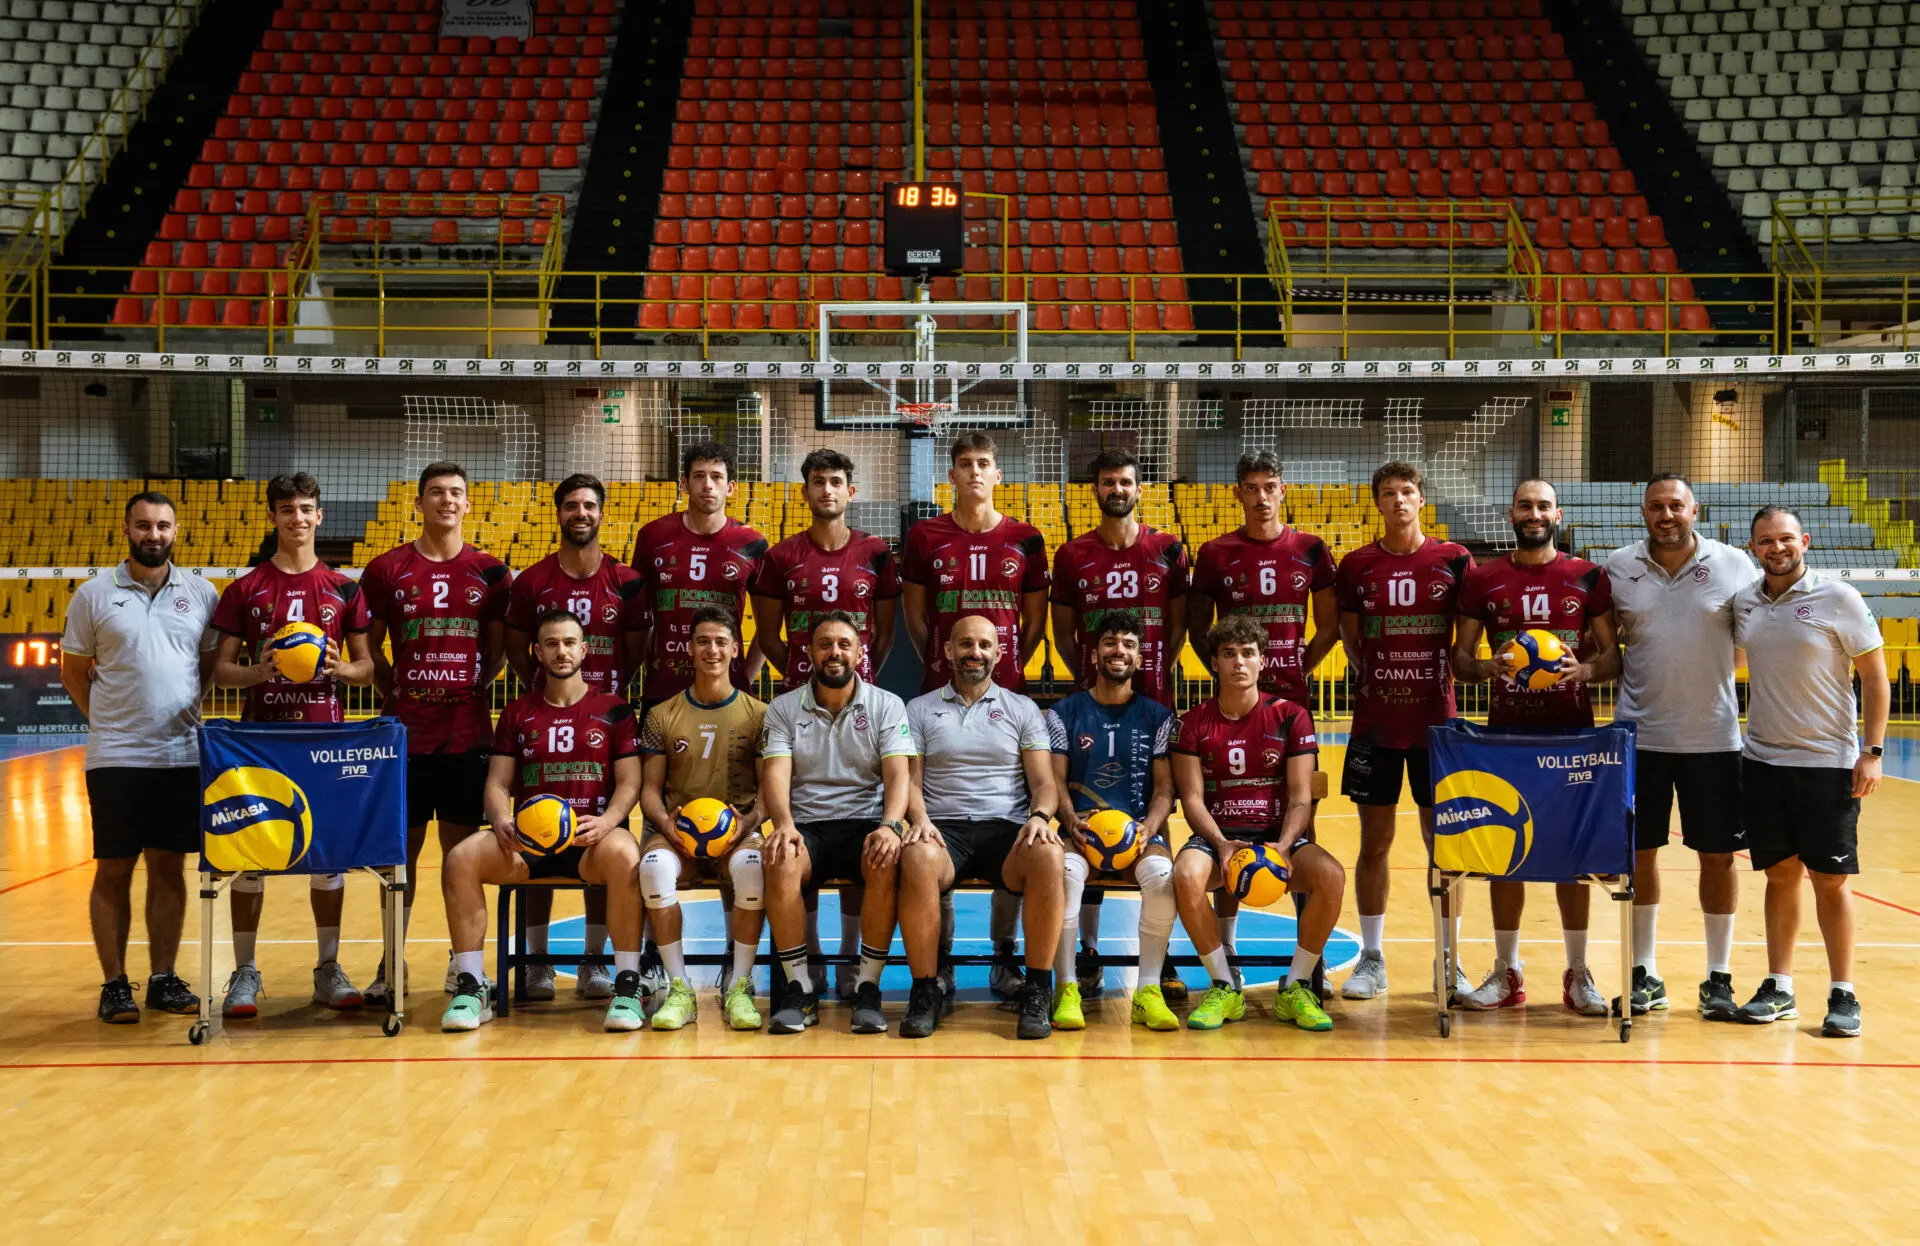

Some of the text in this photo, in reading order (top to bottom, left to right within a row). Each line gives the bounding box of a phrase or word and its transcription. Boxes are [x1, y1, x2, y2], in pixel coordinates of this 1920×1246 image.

[899, 186, 957, 206] 18 36
[690, 554, 707, 581] 5
[970, 554, 986, 580] 11
[822, 574, 838, 602] 3
[1106, 570, 1138, 598] 23
[1260, 568, 1276, 595] 6
[1388, 579, 1416, 606] 10
[432, 582, 448, 608] 2
[1522, 594, 1550, 620] 14
[287, 599, 304, 622] 4
[567, 598, 592, 626] 18
[408, 670, 467, 680] CANALE
[1375, 668, 1434, 680] CANALE
[264, 692, 326, 704] CANALE
[548, 726, 574, 753] 13
[701, 732, 716, 758] 7
[1108, 731, 1116, 758] 1
[310, 746, 398, 764] VOLLEYBALL
[1228, 748, 1246, 776] 9
[1537, 752, 1622, 769] VOLLEYBALL
[342, 765, 368, 776] FIVB
[1568, 771, 1592, 782] FIVB
